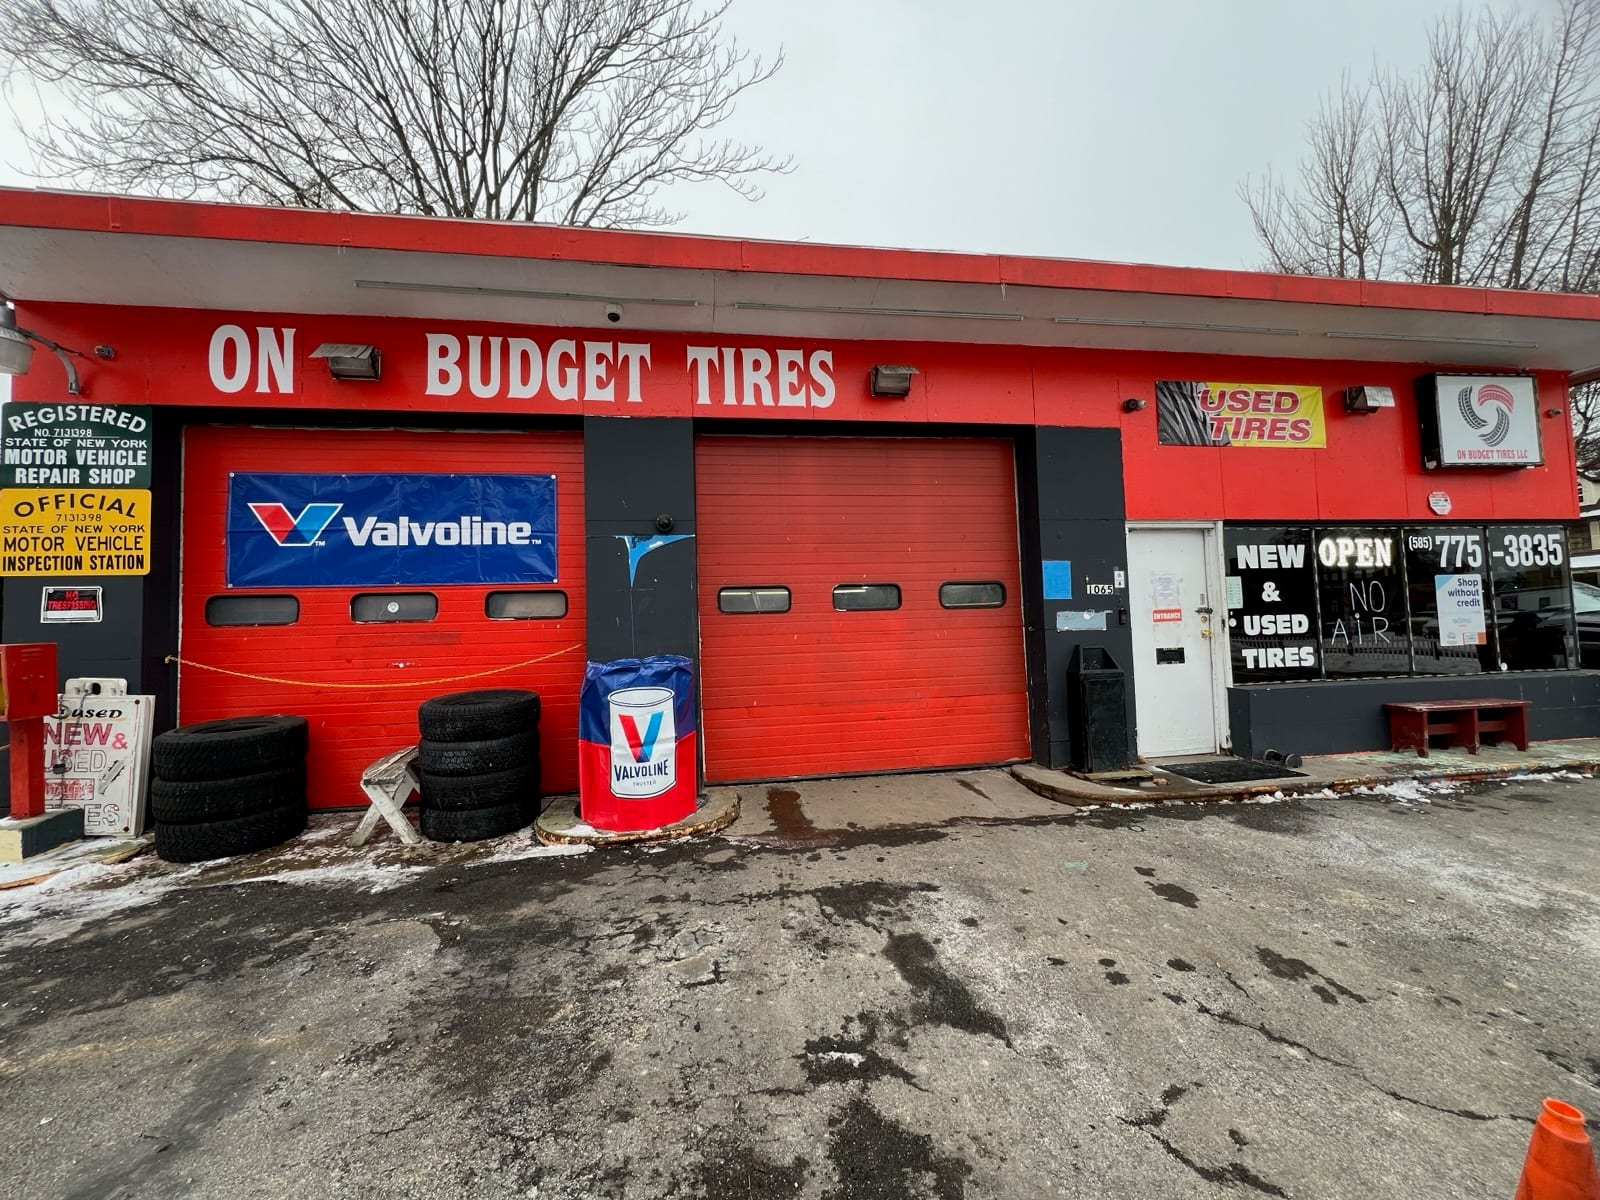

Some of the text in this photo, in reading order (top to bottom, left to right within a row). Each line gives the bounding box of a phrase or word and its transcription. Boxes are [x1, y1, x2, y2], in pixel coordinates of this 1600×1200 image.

[208, 324, 836, 409] ON BUDGET TIRES
[1200, 388, 1300, 414] USED
[8, 405, 147, 433] REGISTERED
[1208, 416, 1312, 442] TIRES
[5, 438, 147, 449] STATE OF NEW YORK
[34, 428, 93, 438] NO. 7131398
[4, 448, 147, 466] MOTOR VEHICLE
[1456, 449, 1529, 460] ON BUDGET TIRES LLC
[15, 467, 136, 485] REPAIR SHOP
[14, 493, 136, 519] OFFICIAL
[56, 513, 102, 522] 7131398
[3, 524, 146, 534] STATE OF NEW YORK
[342, 516, 532, 547] Valvoline
[4, 535, 144, 552] MOTOR VEHICLE
[1318, 537, 1393, 567] OPEN
[1408, 535, 1433, 551] (585)
[1435, 534, 1483, 568] 775
[2, 554, 145, 572] INSPECTION STATION
[1236, 544, 1306, 569] NEW
[1088, 585, 1113, 595] 1065
[1261, 581, 1282, 602] &
[1448, 588, 1480, 597] without
[1457, 578, 1478, 588] Shop
[1349, 580, 1386, 612] NO
[1456, 598, 1481, 607] credit
[1243, 613, 1309, 636] USED
[1241, 646, 1315, 669] TIRES
[44, 722, 128, 750] NEW &
[614, 759, 669, 782] VALVOLINE
[633, 779, 657, 788] TRUSTED
